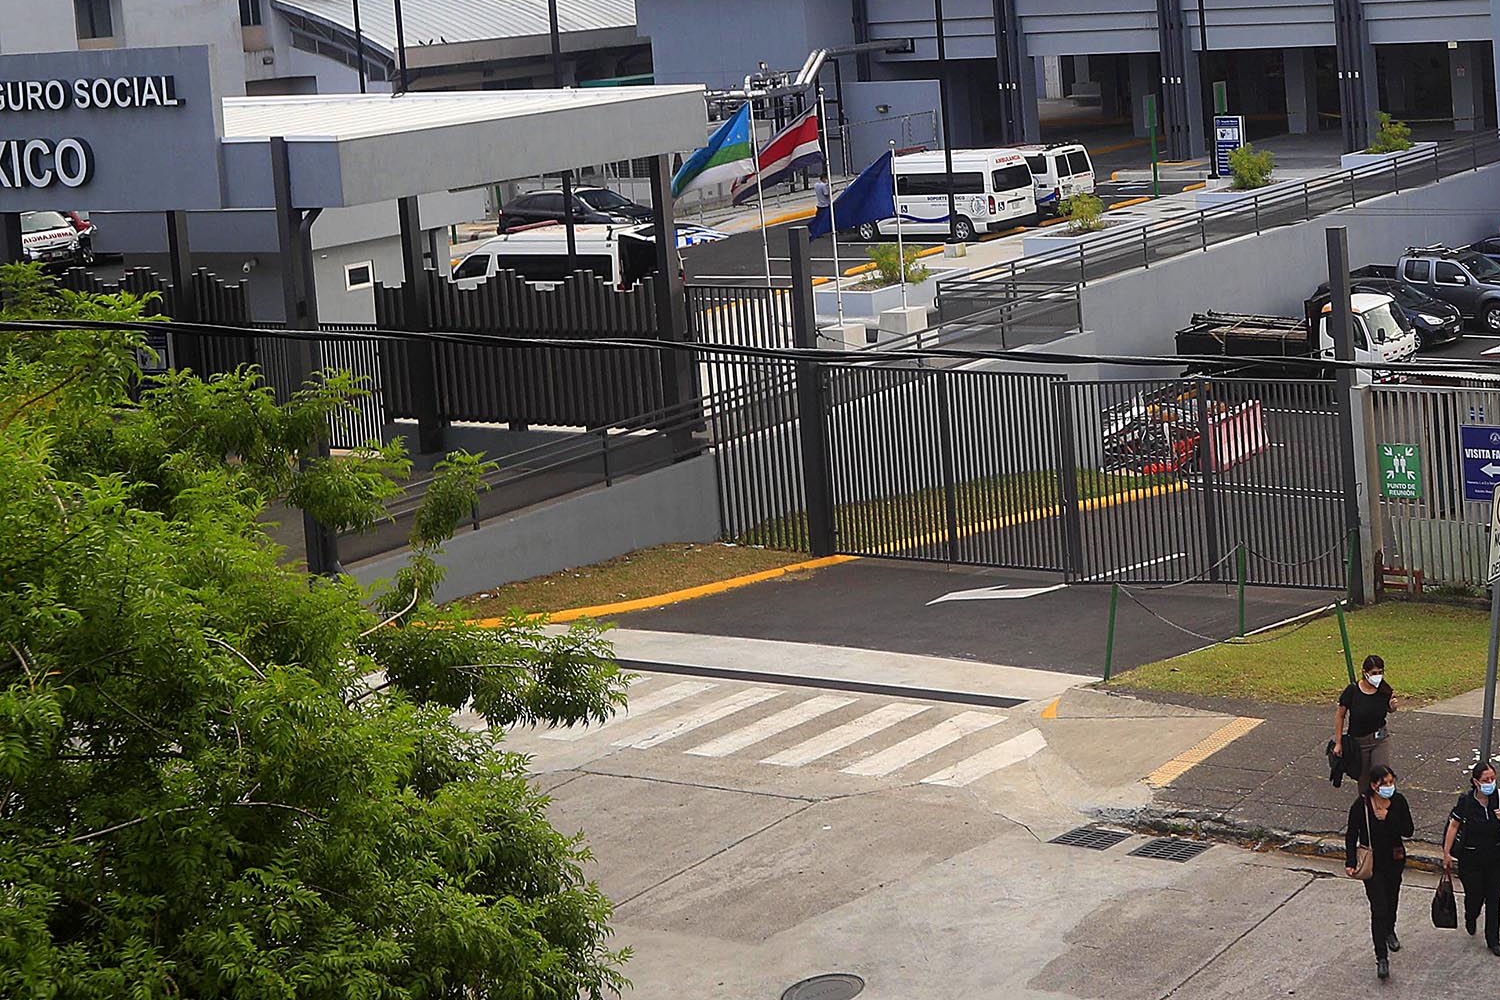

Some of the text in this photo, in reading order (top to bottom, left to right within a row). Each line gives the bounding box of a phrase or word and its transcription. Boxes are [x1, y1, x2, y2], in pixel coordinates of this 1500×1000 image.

[73, 76, 178, 109] SOCIAL
[1465, 448, 1491, 459] VISITA
[1389, 489, 1416, 497] REUNIÓN
